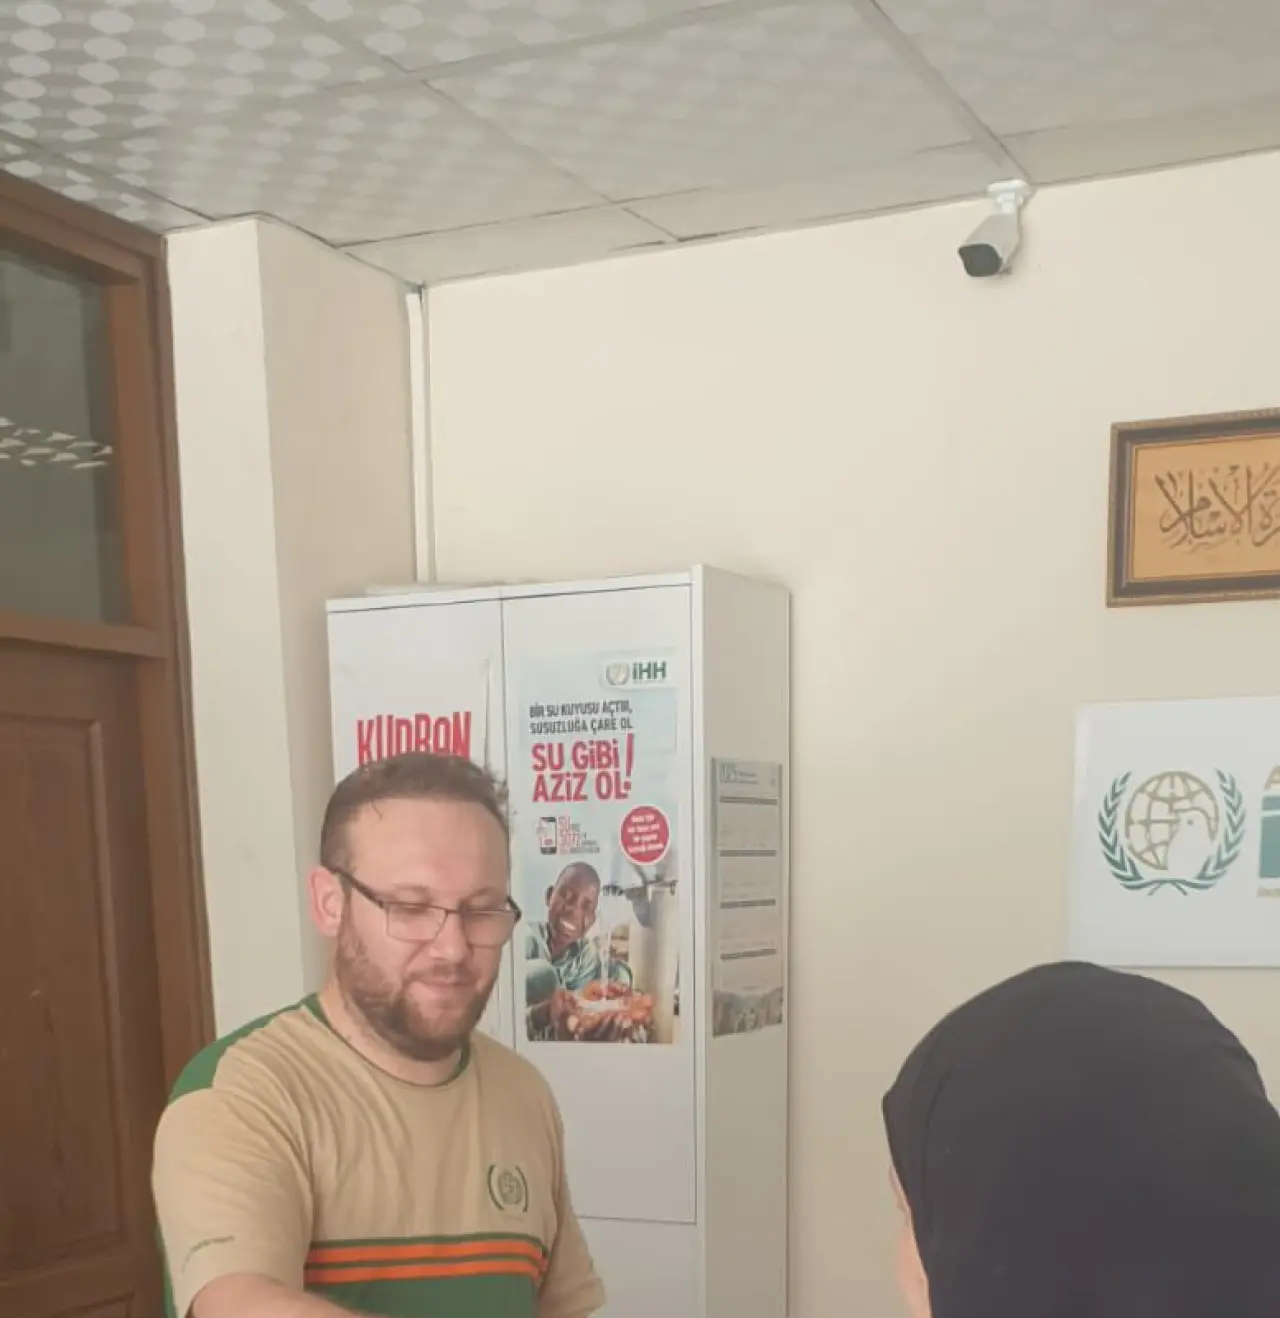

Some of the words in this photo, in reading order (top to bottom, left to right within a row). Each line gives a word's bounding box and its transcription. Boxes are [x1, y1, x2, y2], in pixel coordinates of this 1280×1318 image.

[591, 717, 617, 735] ÇARE
[620, 716, 634, 729] OL
[532, 742, 565, 771] SU
